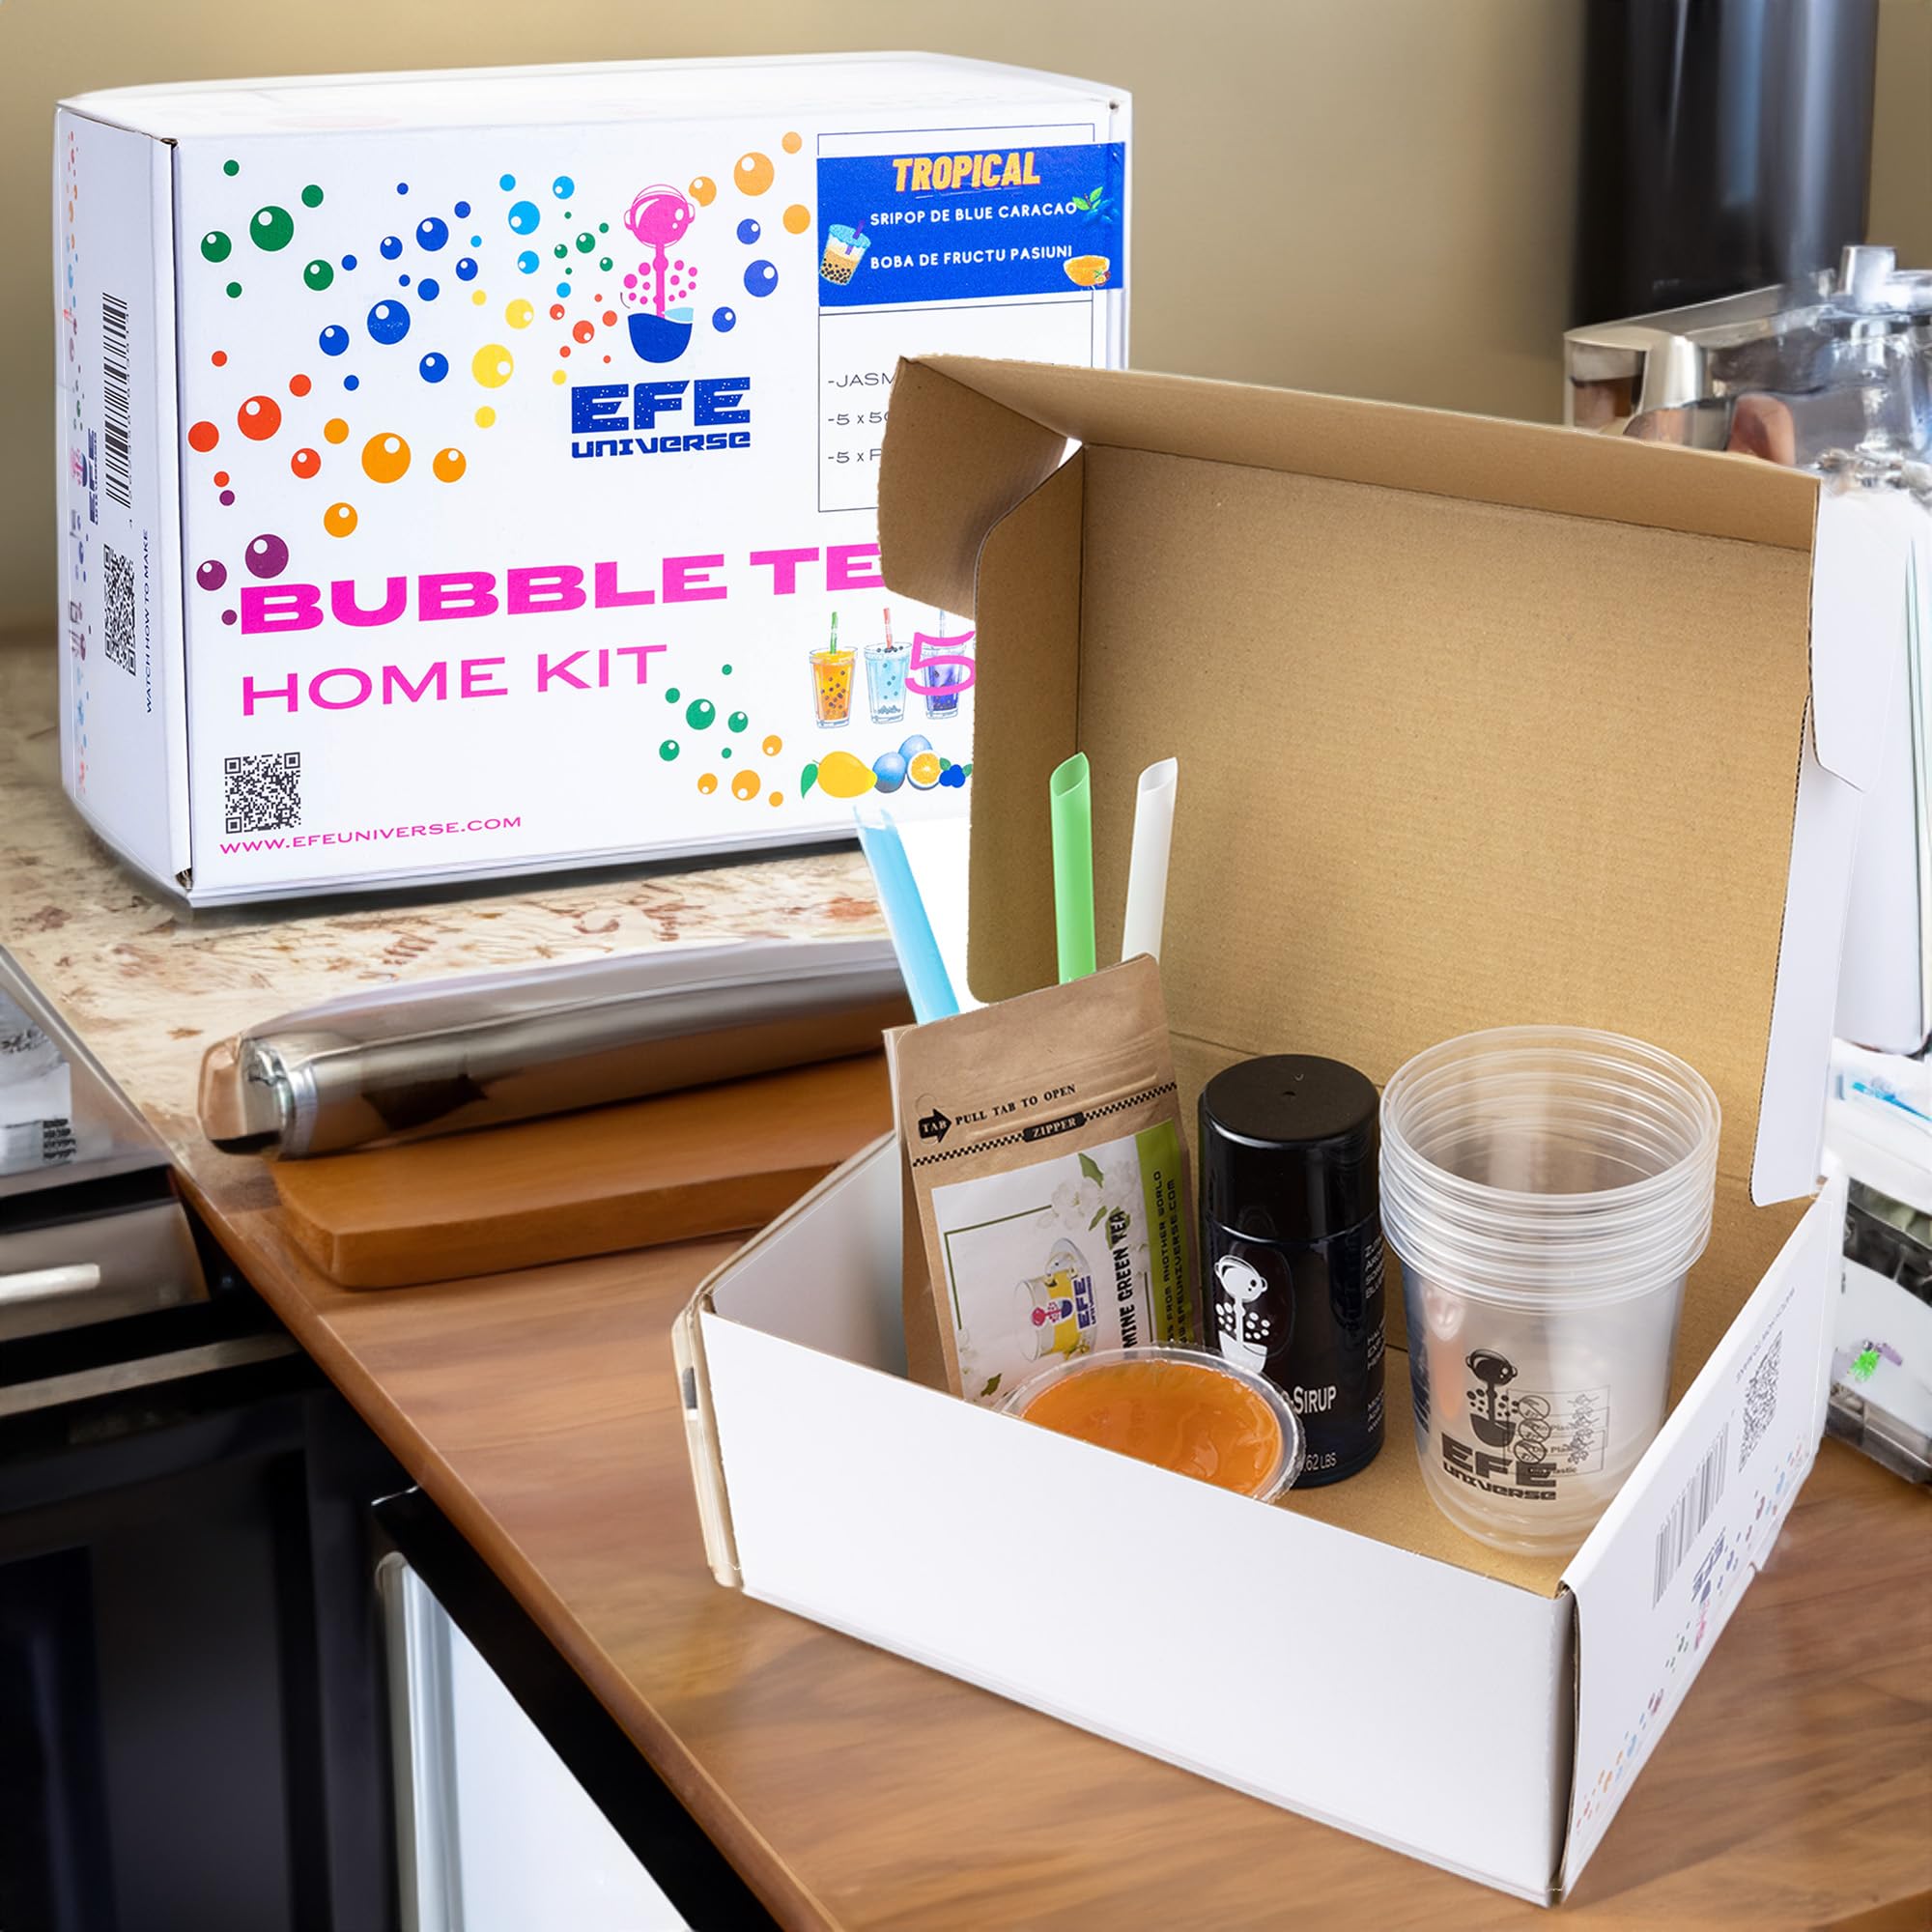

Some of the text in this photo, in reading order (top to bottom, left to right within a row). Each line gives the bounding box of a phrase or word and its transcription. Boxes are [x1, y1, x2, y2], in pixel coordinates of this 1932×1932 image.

[892, 151, 1041, 193] TROPICAL
[869, 201, 1078, 227] SRIPOP DE BLUE CARACAO
[870, 244, 1073, 270] BOBA DE FRUCTU PASIUNI
[571, 377, 751, 434] EFE
[241, 554, 727, 635] BUBBLE
[242, 643, 668, 717] HOME KIT
[219, 816, 522, 855] WWW.EFEUNIVERSE.COM
[922, 1084, 1077, 1134] TAB PULL TAB TO OPEN
[1032, 1118, 1078, 1138] ZIPPER
[1152, 1170, 1165, 1216] WORLD
[1109, 1210, 1128, 1245] TEA
[1112, 1246, 1136, 1303] GREEN
[1158, 1221, 1171, 1283] ANOTHER
[1073, 1277, 1091, 1329] EFE
[1164, 1287, 1174, 1321] FROM
[1320, 1451, 1338, 1469] LBS
[1440, 1432, 1557, 1488] EFE
